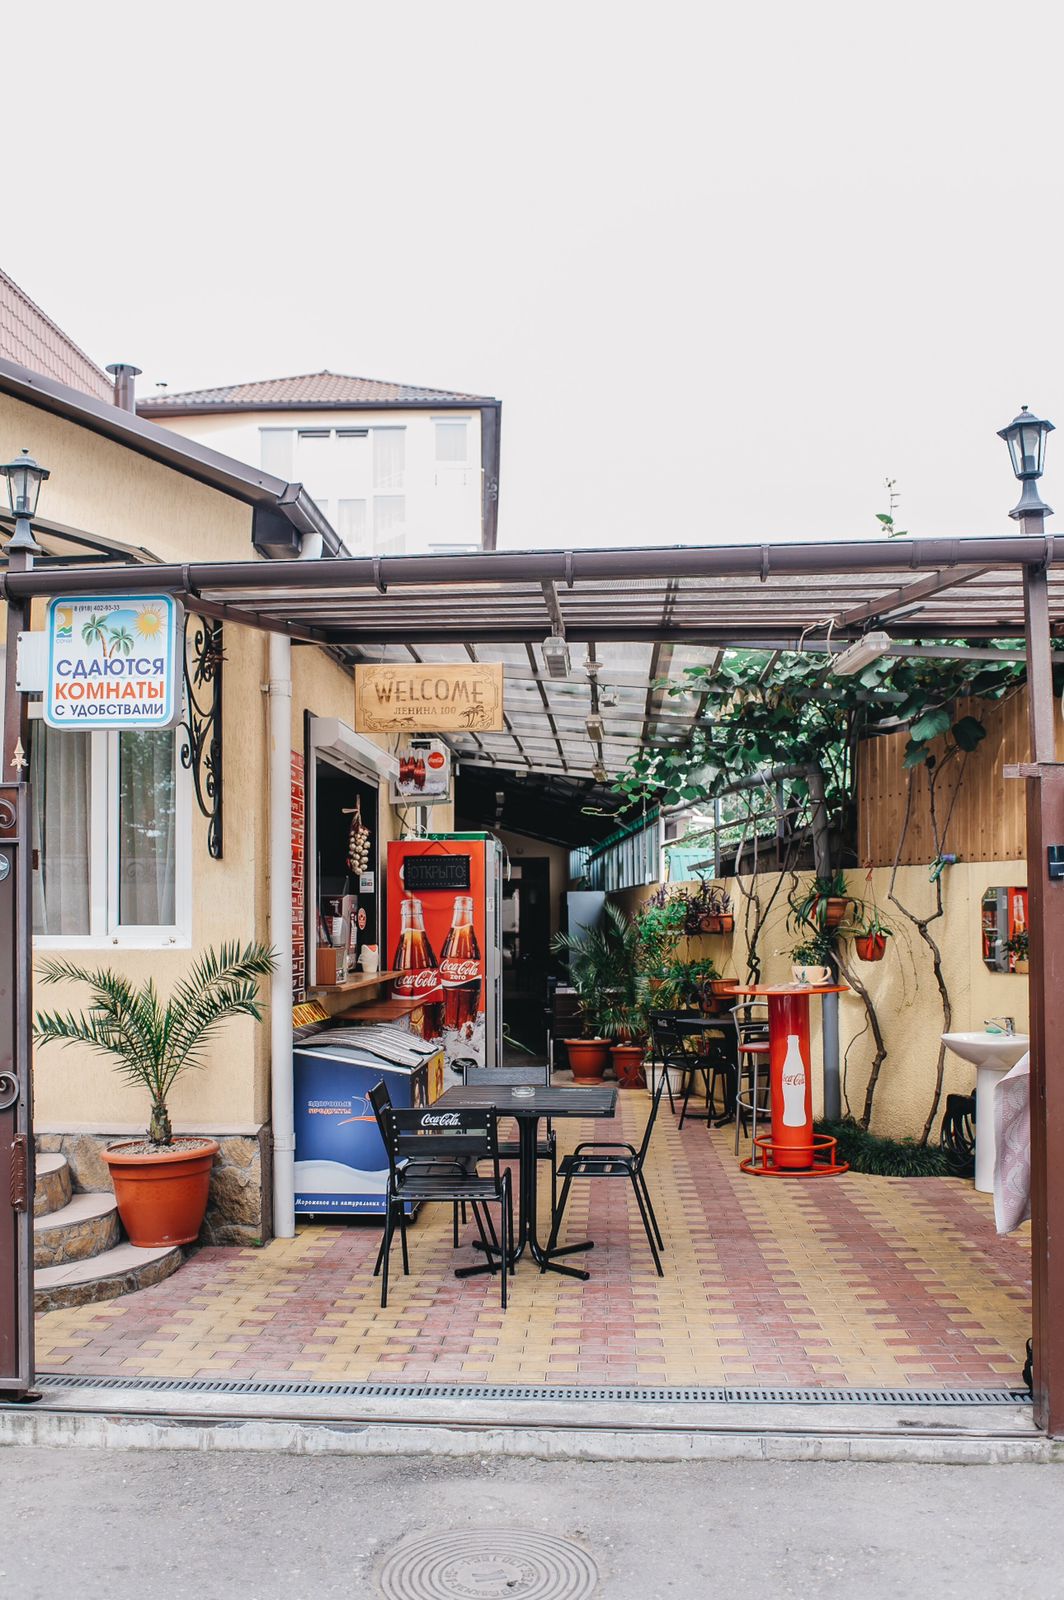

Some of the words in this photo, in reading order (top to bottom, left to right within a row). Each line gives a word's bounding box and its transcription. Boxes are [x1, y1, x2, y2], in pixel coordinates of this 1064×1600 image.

[56, 658, 164, 679] СДАЮТСЯ
[55, 681, 164, 700] КОМНАТЫ
[375, 679, 484, 704] WELCOME
[55, 705, 65, 716] С
[71, 703, 163, 717] УДОБСТВАМИ
[393, 706, 437, 715] ЛЕНИНА
[440, 706, 457, 715] 100
[410, 865, 465, 879] ОТКРЫТО
[439, 959, 480, 976] Coca-Cola
[421, 1112, 461, 1127] Coca-Cola
